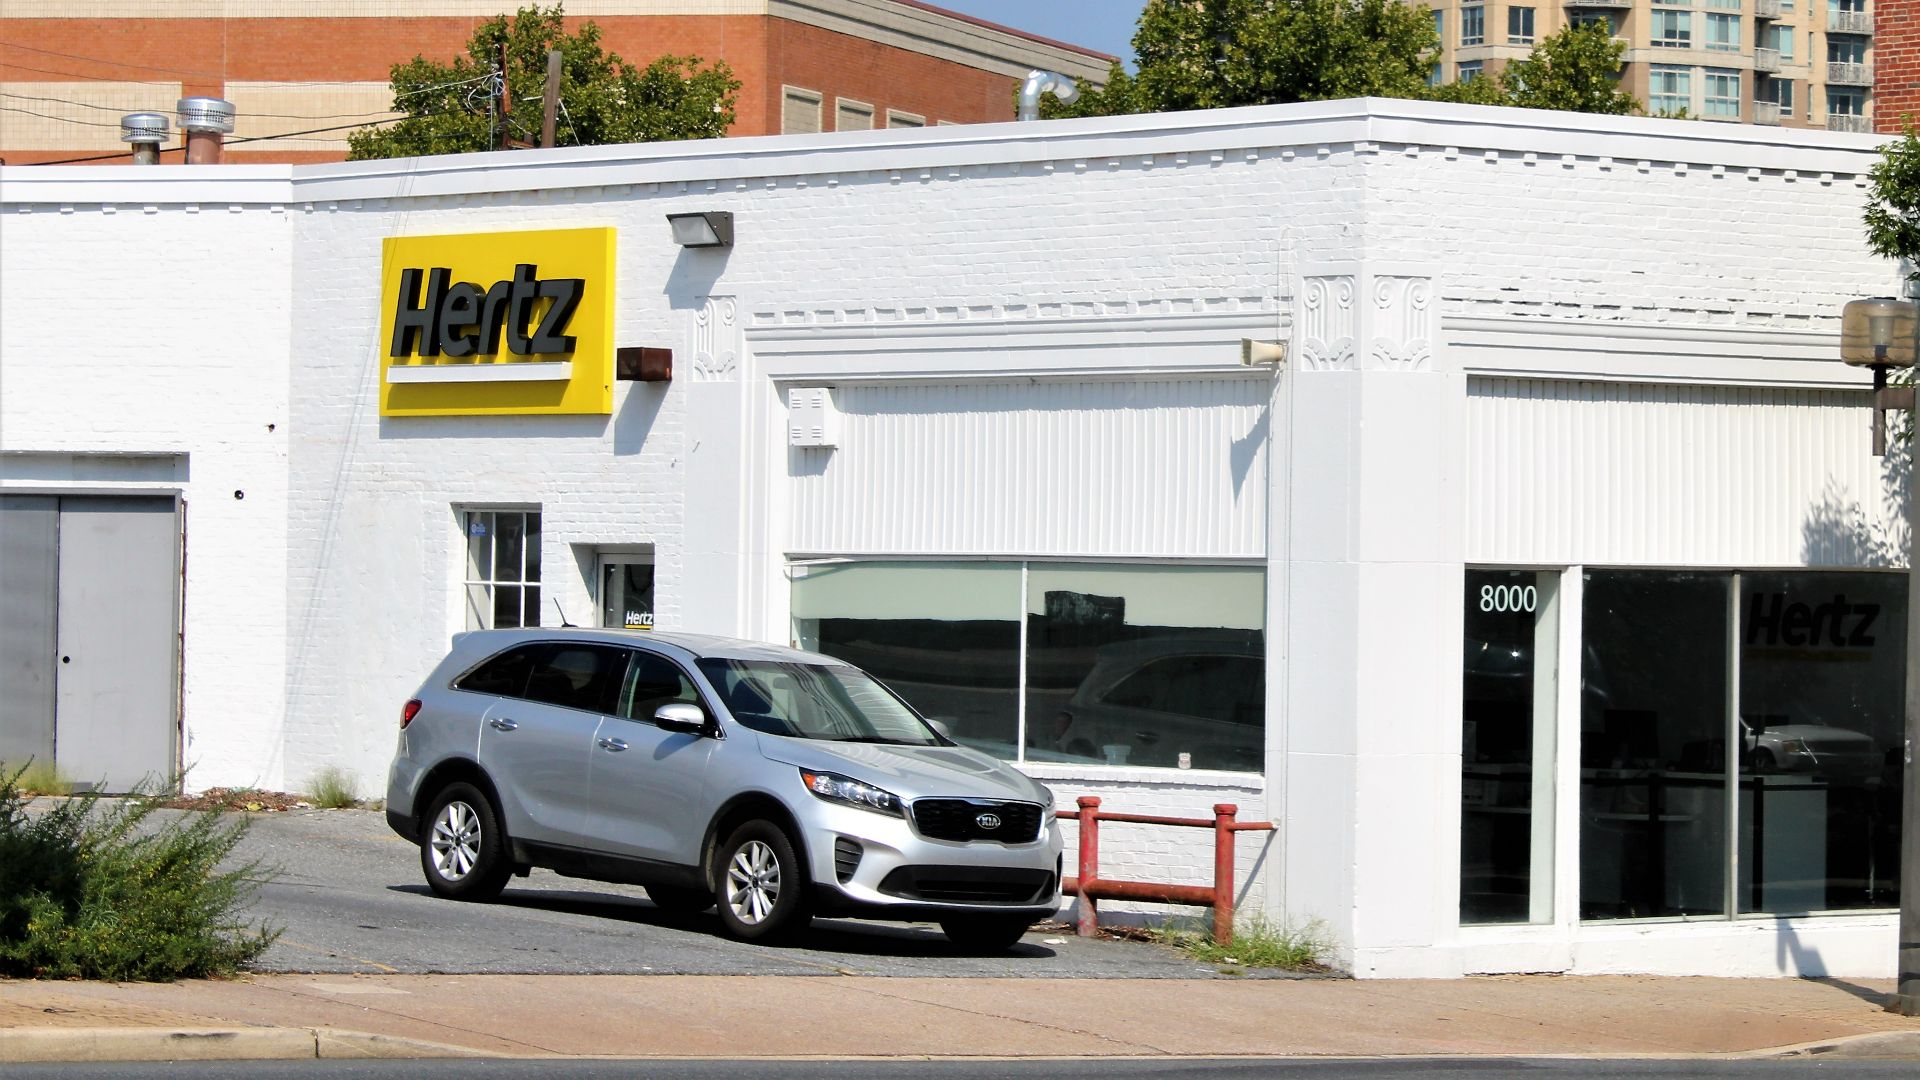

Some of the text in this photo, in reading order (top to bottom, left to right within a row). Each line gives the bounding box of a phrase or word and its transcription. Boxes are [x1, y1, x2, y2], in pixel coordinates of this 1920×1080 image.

[390, 264, 585, 357] Hertz
[1480, 584, 1537, 613] 8000
[625, 610, 653, 625] Hertz
[1746, 592, 1881, 647] Hertz
[981, 816, 999, 827] KIA
